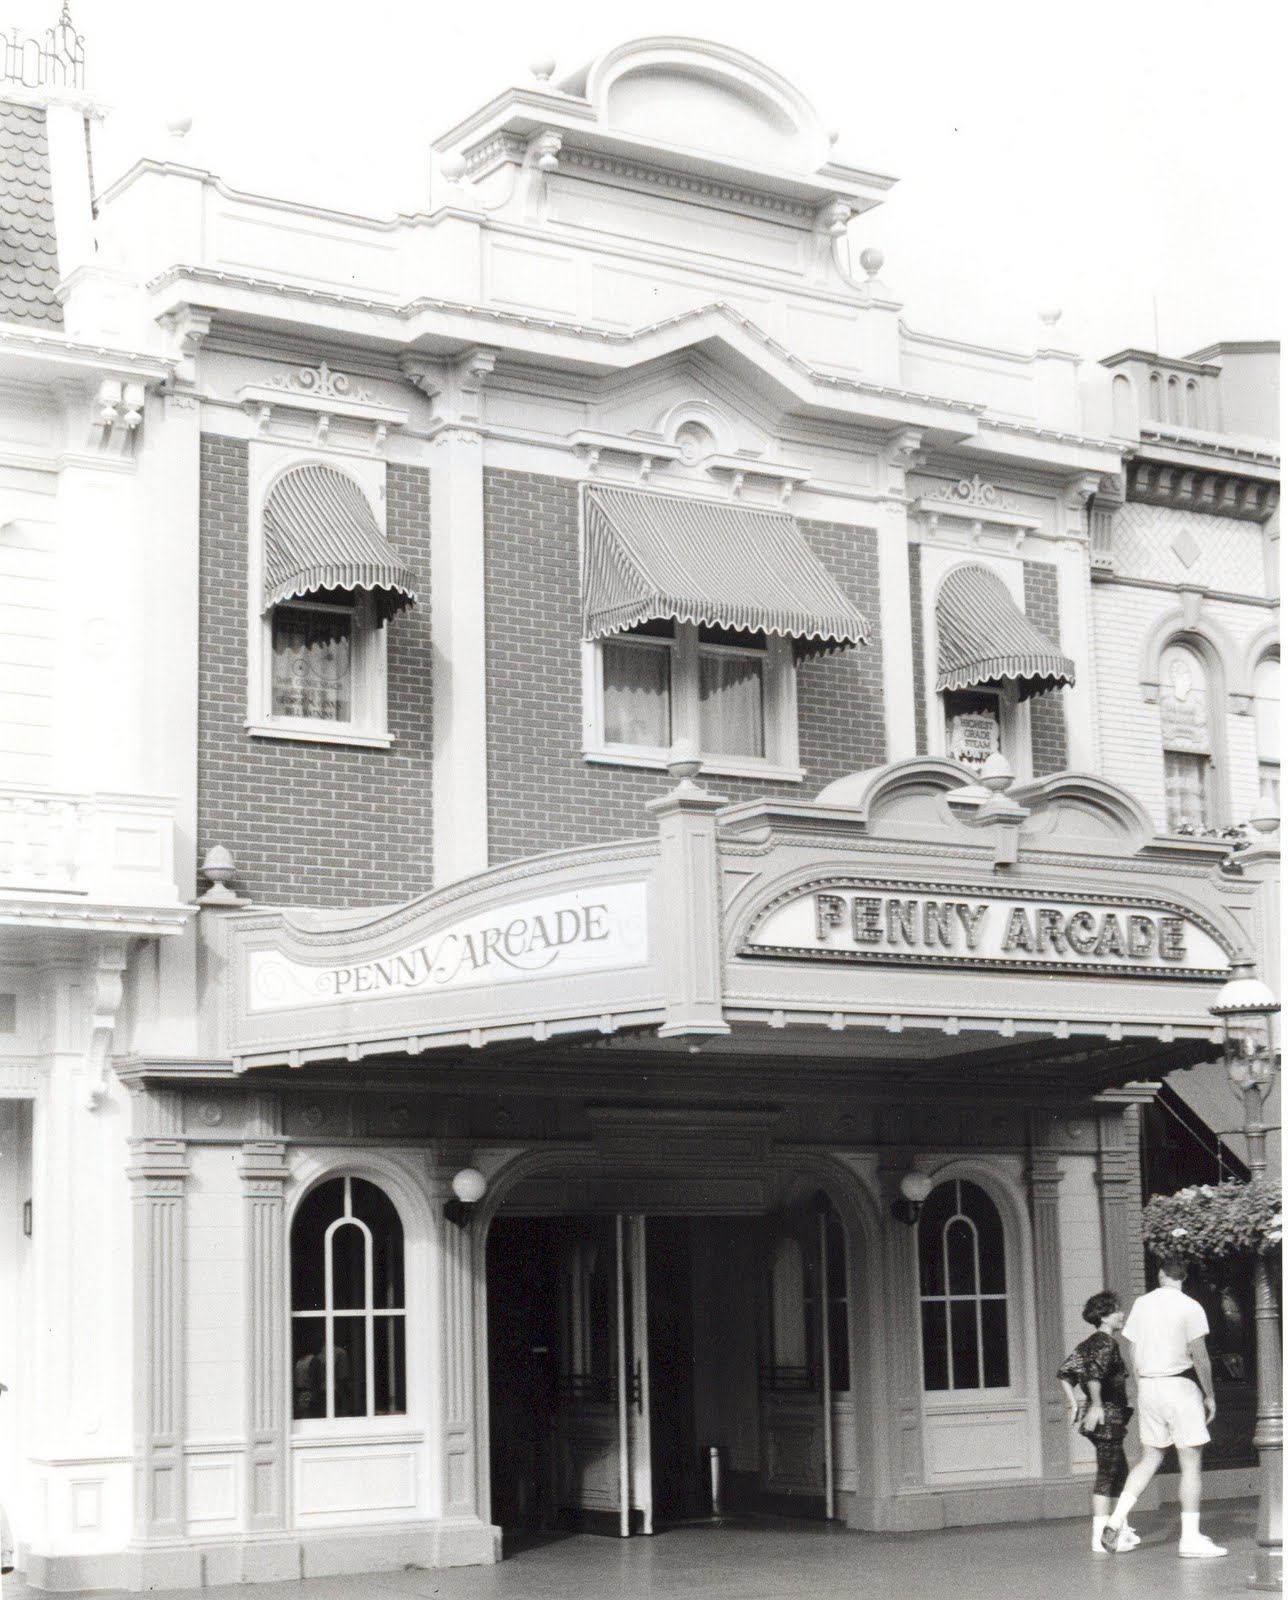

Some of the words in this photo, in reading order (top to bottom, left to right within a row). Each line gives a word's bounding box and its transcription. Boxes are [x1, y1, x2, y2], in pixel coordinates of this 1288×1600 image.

[963, 729, 991, 740] GRADE
[964, 739, 991, 749] STEAM
[815, 893, 988, 948] PENNY
[1001, 906, 1187, 960] ARCADE
[330, 936, 457, 994] PENNY
[438, 903, 610, 983] ARCADE
